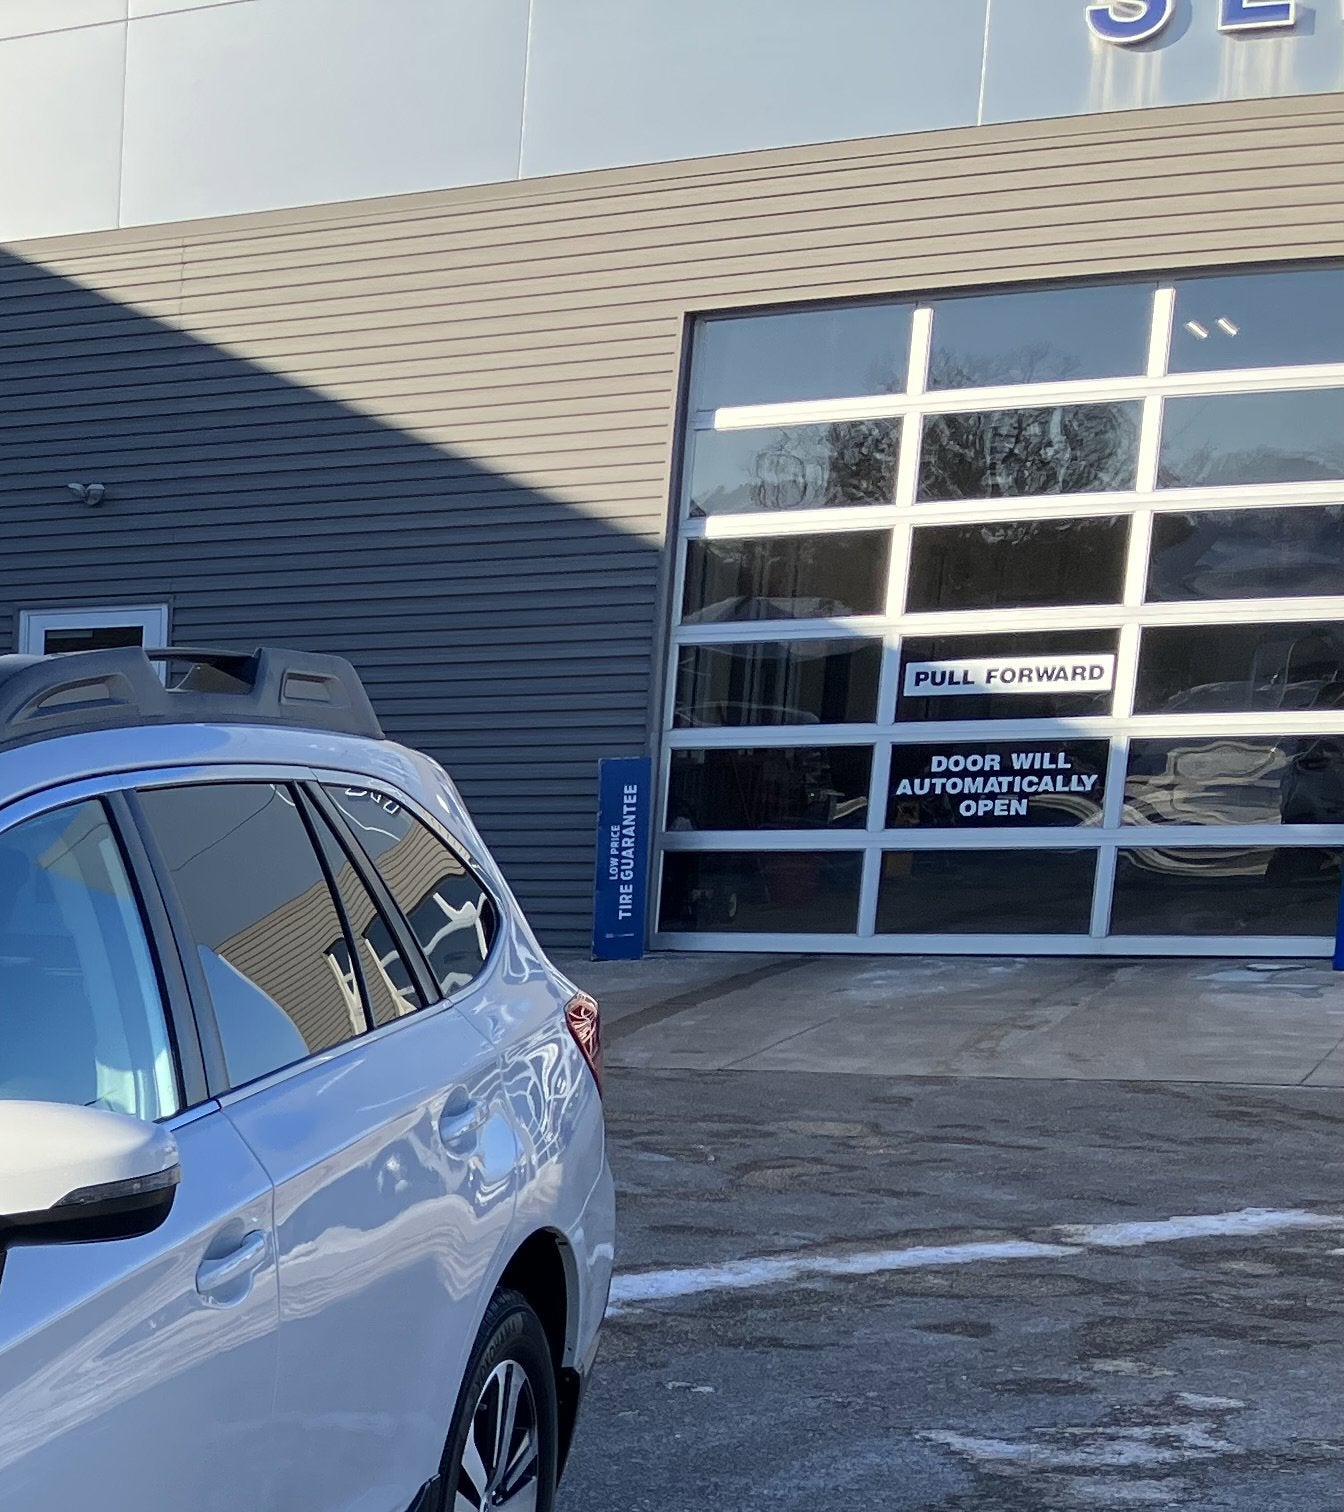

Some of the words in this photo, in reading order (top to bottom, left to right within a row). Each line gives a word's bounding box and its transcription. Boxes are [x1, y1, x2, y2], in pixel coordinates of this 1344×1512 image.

[914, 669, 974, 686] PULL
[985, 664, 1105, 685] FORWARD
[931, 754, 1001, 773] DOOR
[1012, 752, 1072, 770] WILL
[896, 774, 1099, 796] AUTOMATICALLY
[959, 799, 1028, 817] OPEN
[610, 824, 621, 855] PRICE
[620, 784, 638, 881] GUARANTEE
[609, 858, 620, 880] LOW
[618, 883, 633, 921] TIRE
